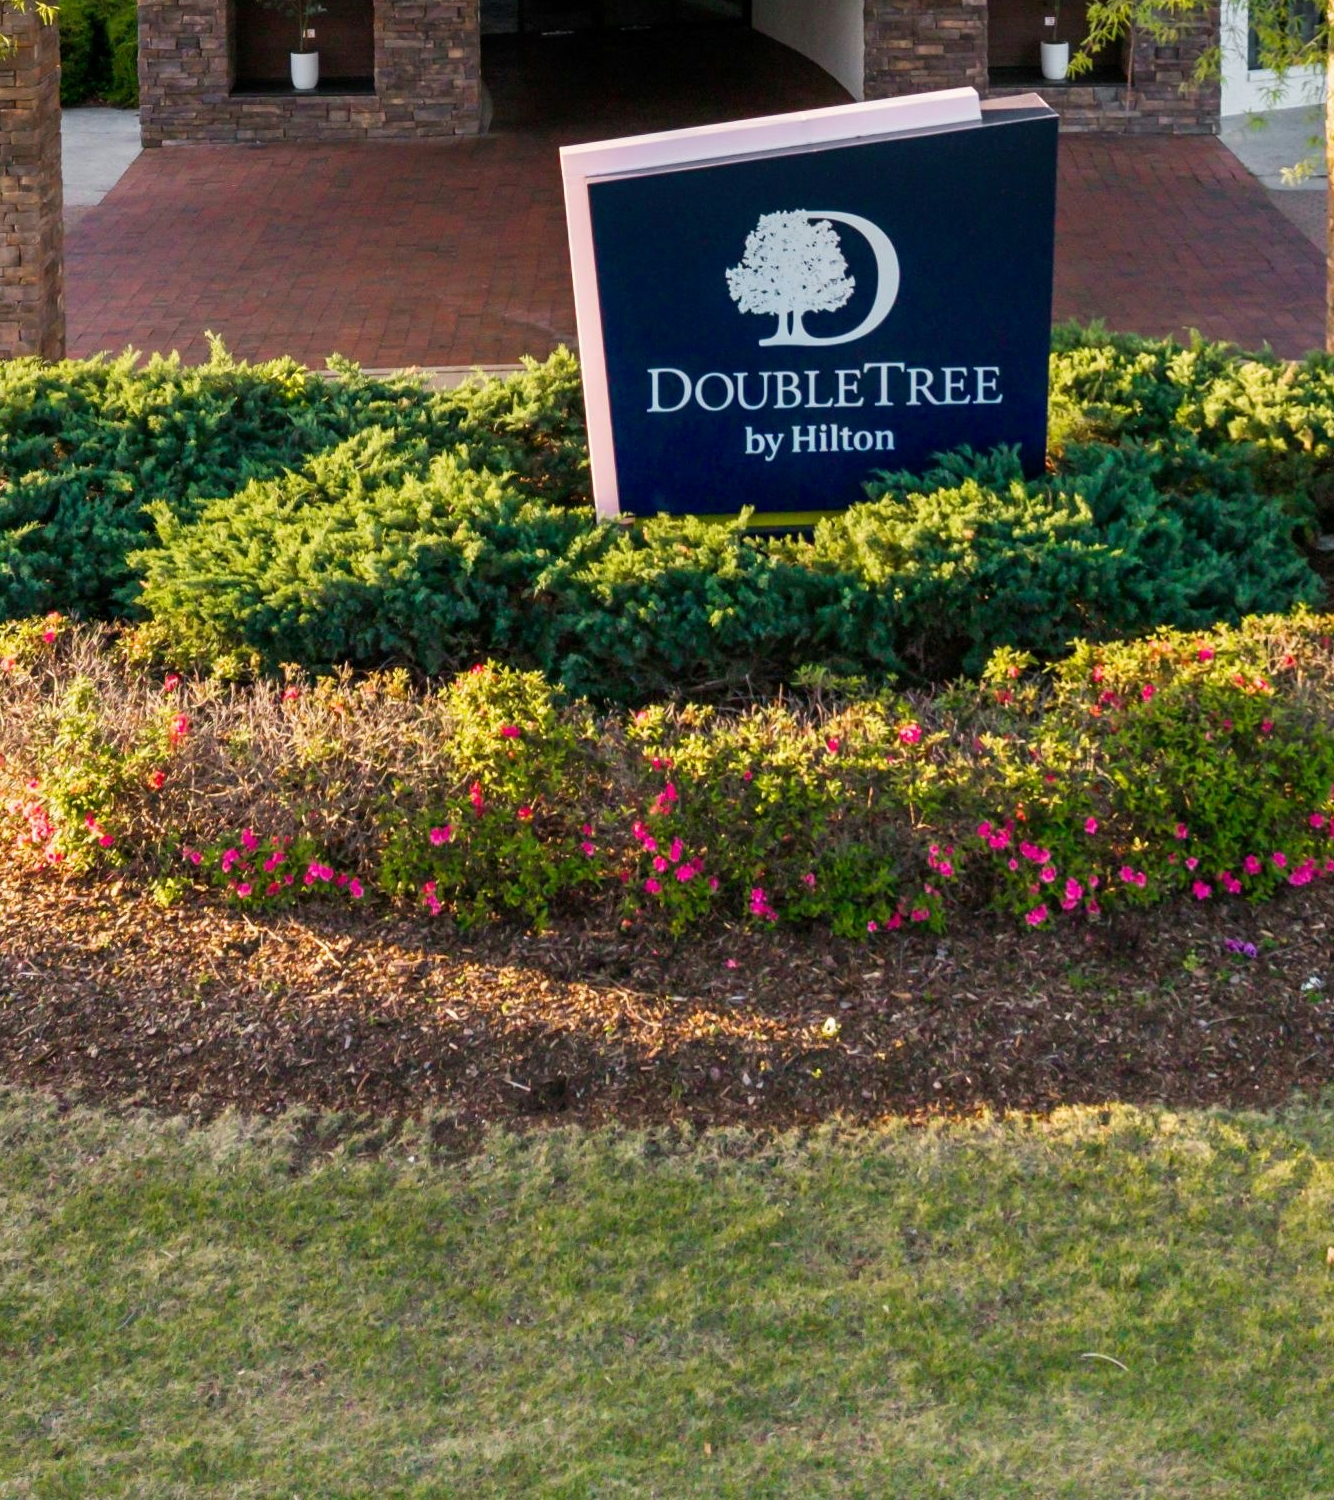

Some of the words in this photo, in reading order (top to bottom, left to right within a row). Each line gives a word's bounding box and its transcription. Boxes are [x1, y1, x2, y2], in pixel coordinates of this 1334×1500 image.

[646, 362, 1003, 413] DOUBLETREE
[745, 426, 785, 462] by
[791, 423, 895, 453] Hilton
